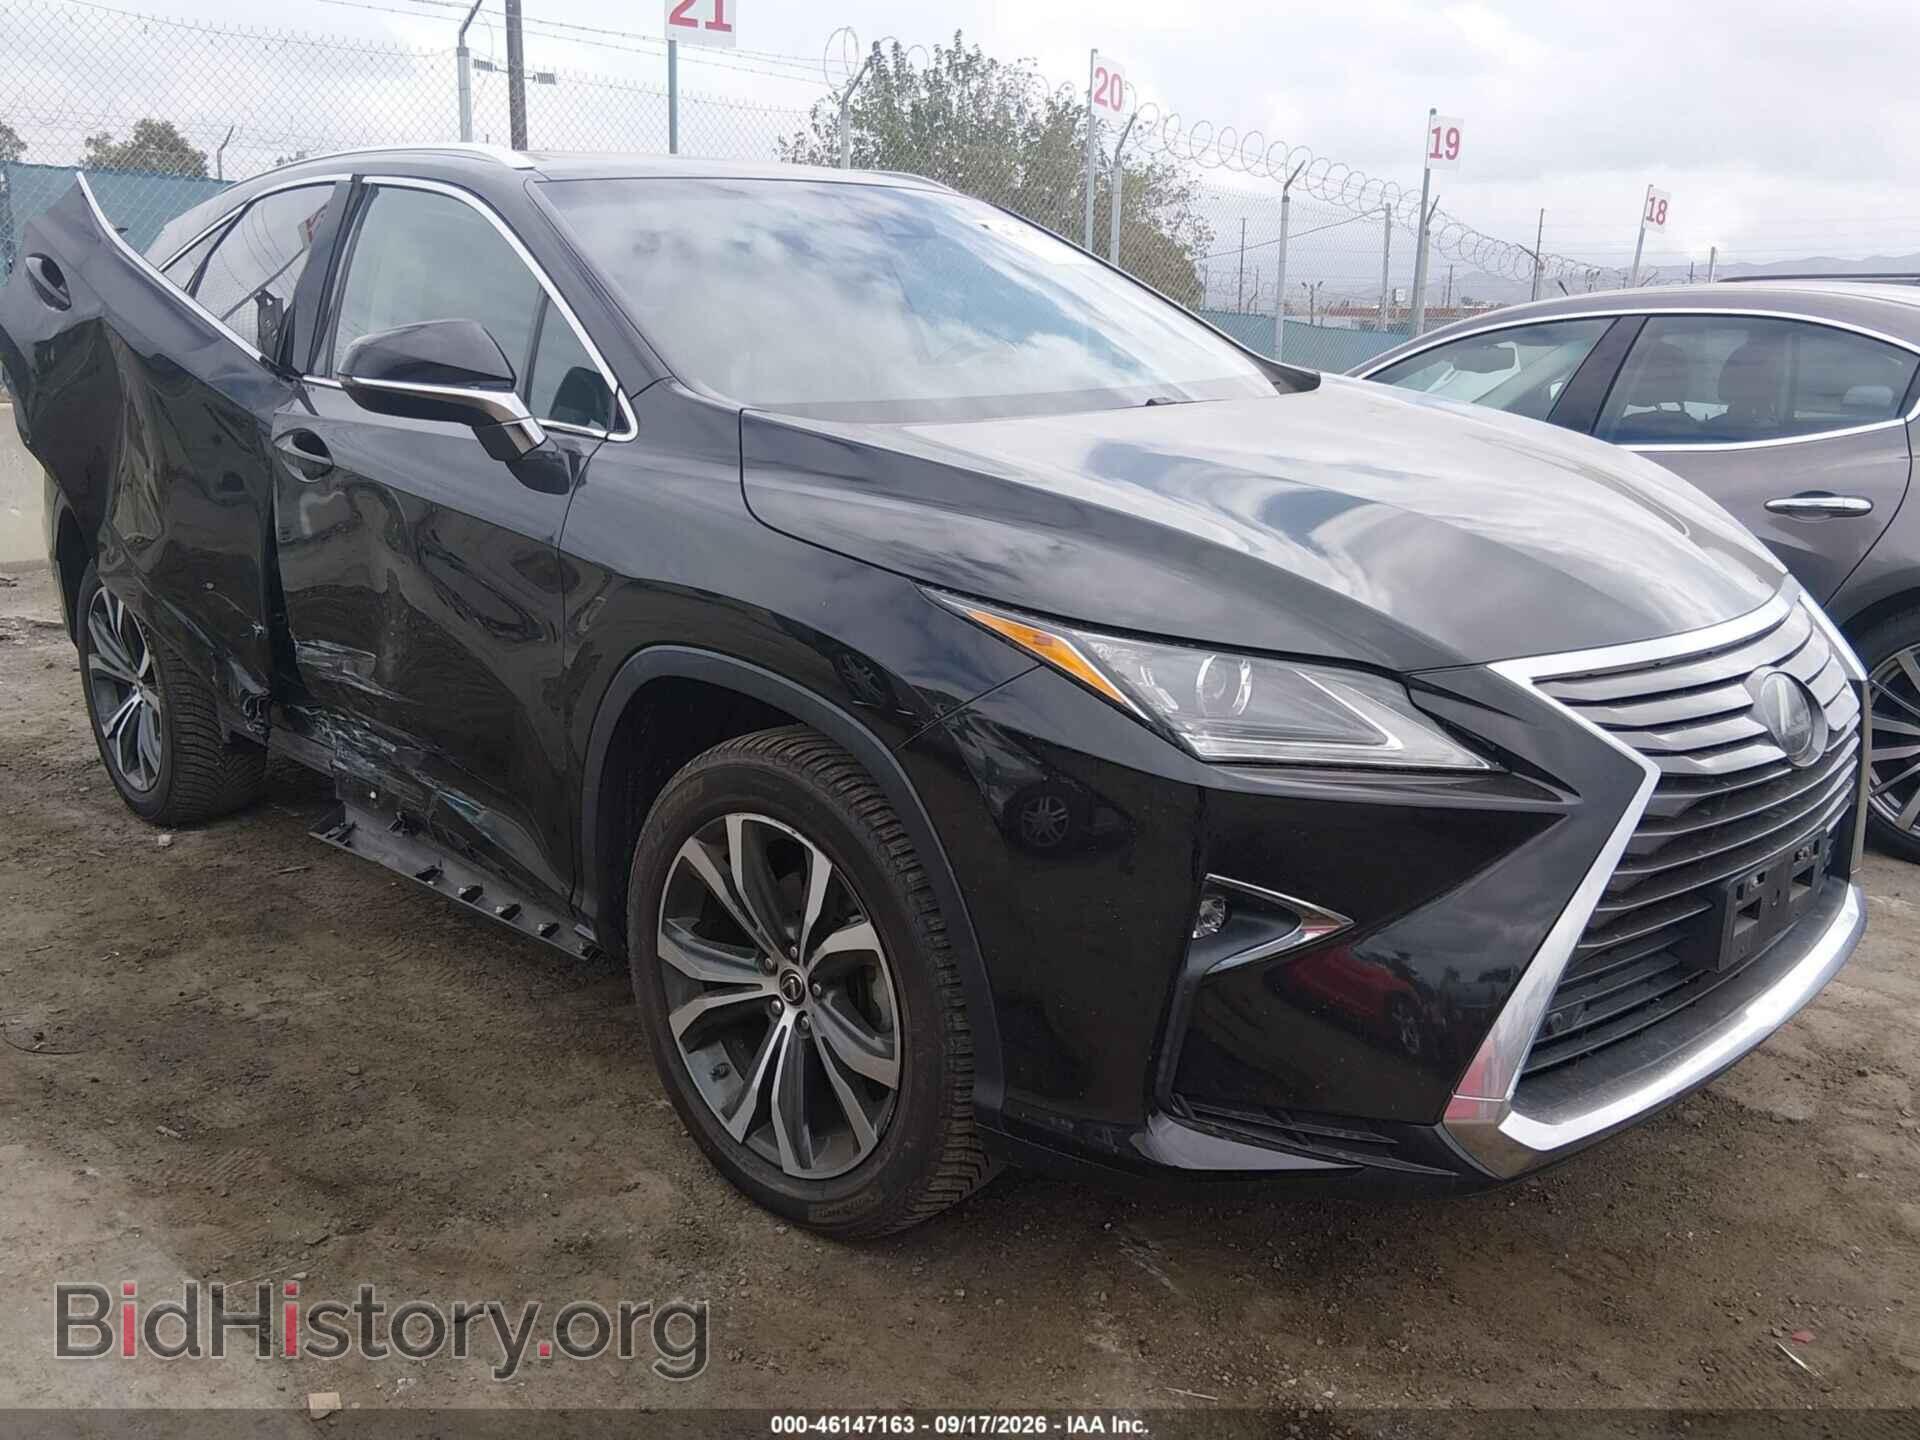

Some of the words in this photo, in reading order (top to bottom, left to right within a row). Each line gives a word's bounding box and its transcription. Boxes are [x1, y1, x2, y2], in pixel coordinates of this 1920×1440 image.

[1094, 66, 1123, 112] 20
[1430, 127, 1460, 160] 19
[1646, 197, 1668, 225] 18
